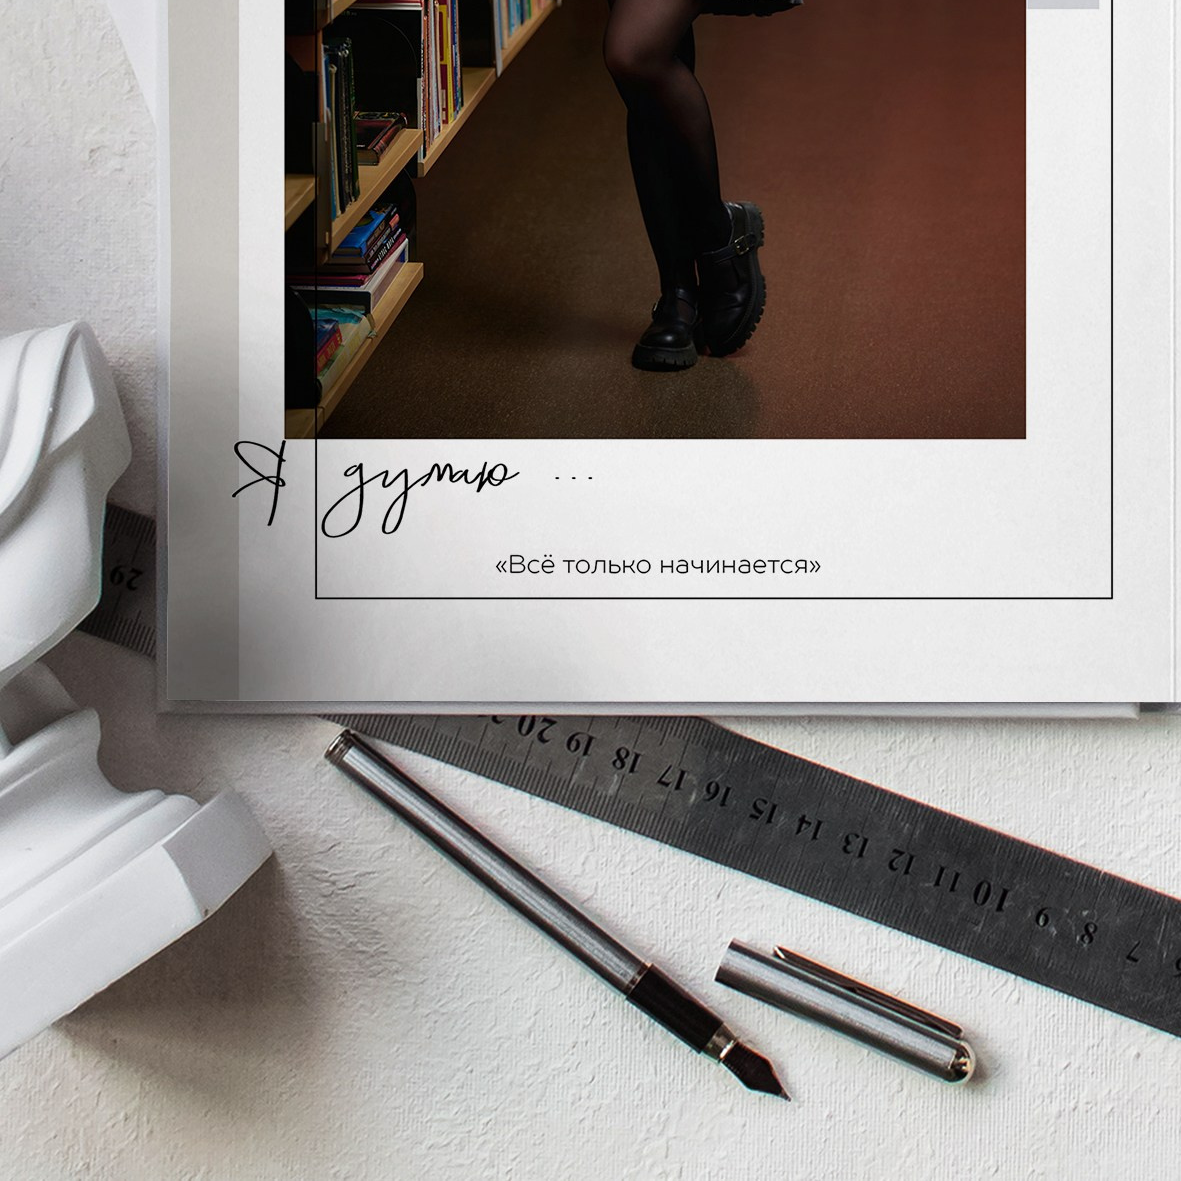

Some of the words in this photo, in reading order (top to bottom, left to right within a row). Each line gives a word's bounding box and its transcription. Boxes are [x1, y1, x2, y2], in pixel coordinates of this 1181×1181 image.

[231, 439, 287, 527] Я
[321, 461, 521, 539] думаю
[494, 553, 556, 575] «Всё
[562, 558, 652, 575] только
[659, 558, 822, 575] начинается»
[110, 565, 143, 591] 29
[517, 715, 558, 744] 20
[566, 731, 598, 757] 19
[612, 746, 645, 774] 18
[656, 764, 689, 791] 17
[703, 780, 732, 808] 16
[749, 797, 778, 824] 15
[795, 814, 823, 841] 14
[842, 832, 869, 858] 13
[888, 848, 916, 875] 12
[933, 866, 961, 892] 11
[973, 880, 1010, 912] 10
[1035, 907, 1050, 928] 9
[1080, 922, 1098, 945] 8
[1126, 940, 1141, 963] 7
